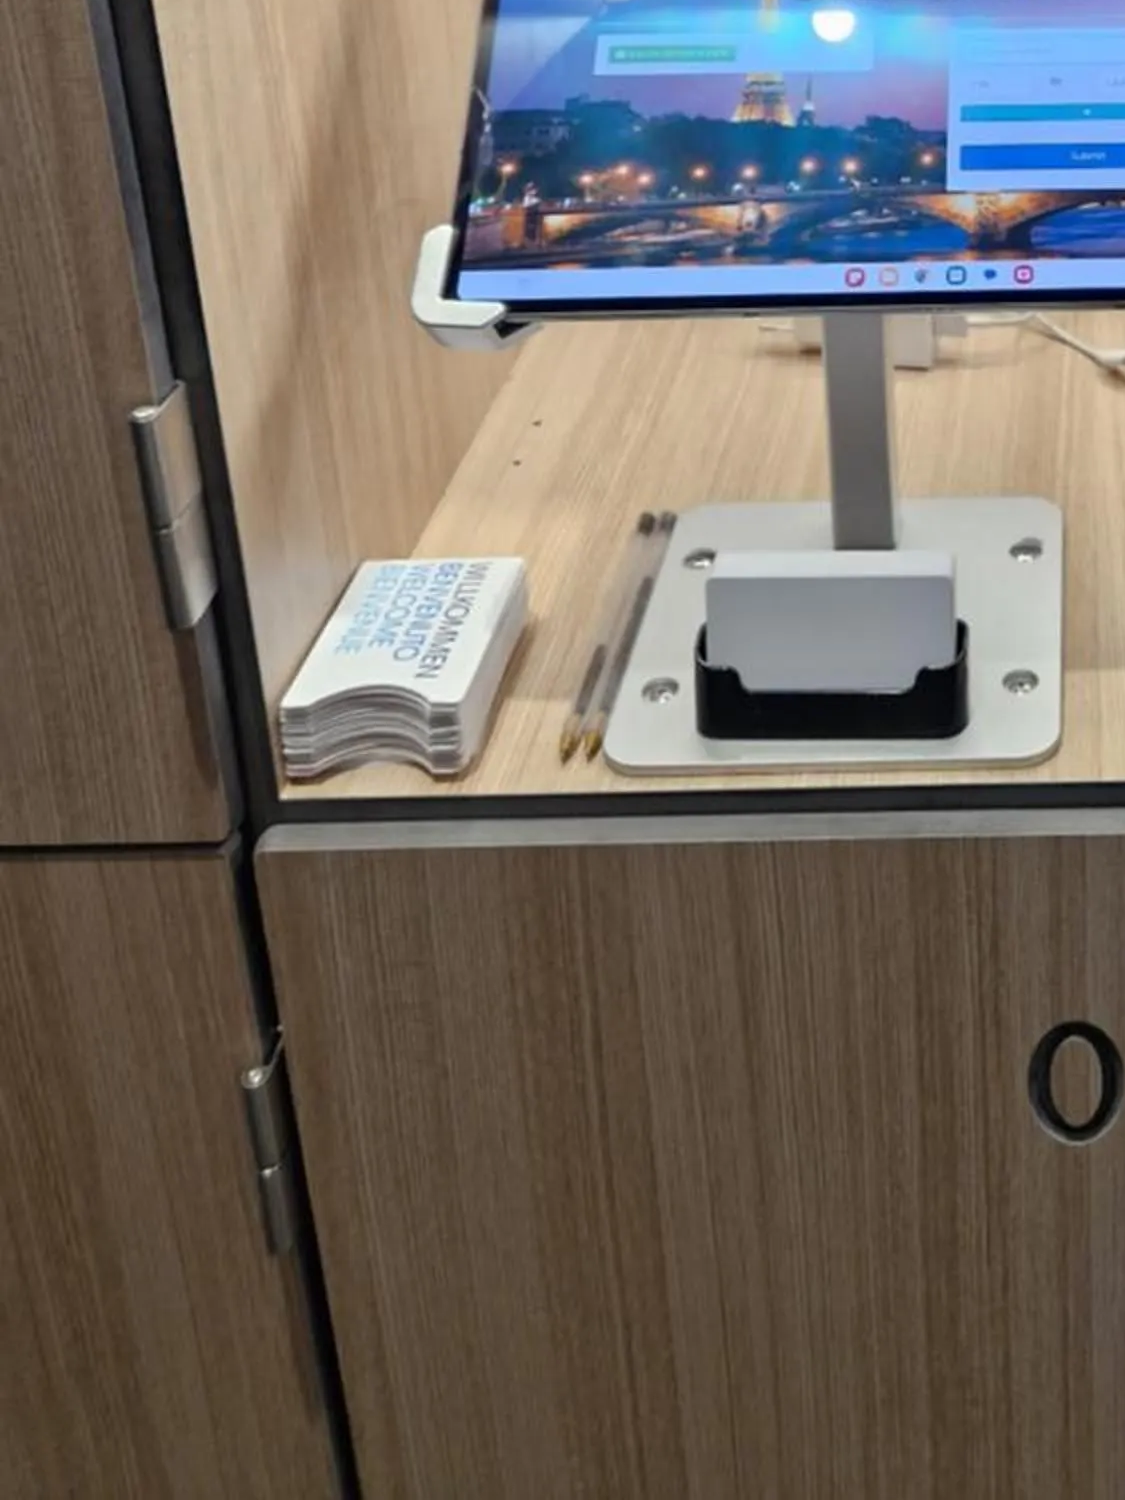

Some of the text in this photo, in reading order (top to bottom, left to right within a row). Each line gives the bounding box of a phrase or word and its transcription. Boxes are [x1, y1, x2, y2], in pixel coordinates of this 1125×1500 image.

[368, 563, 437, 648] WELCOME
[392, 562, 465, 662] BENVENUTO
[414, 561, 495, 679] WILLKOMMEN
